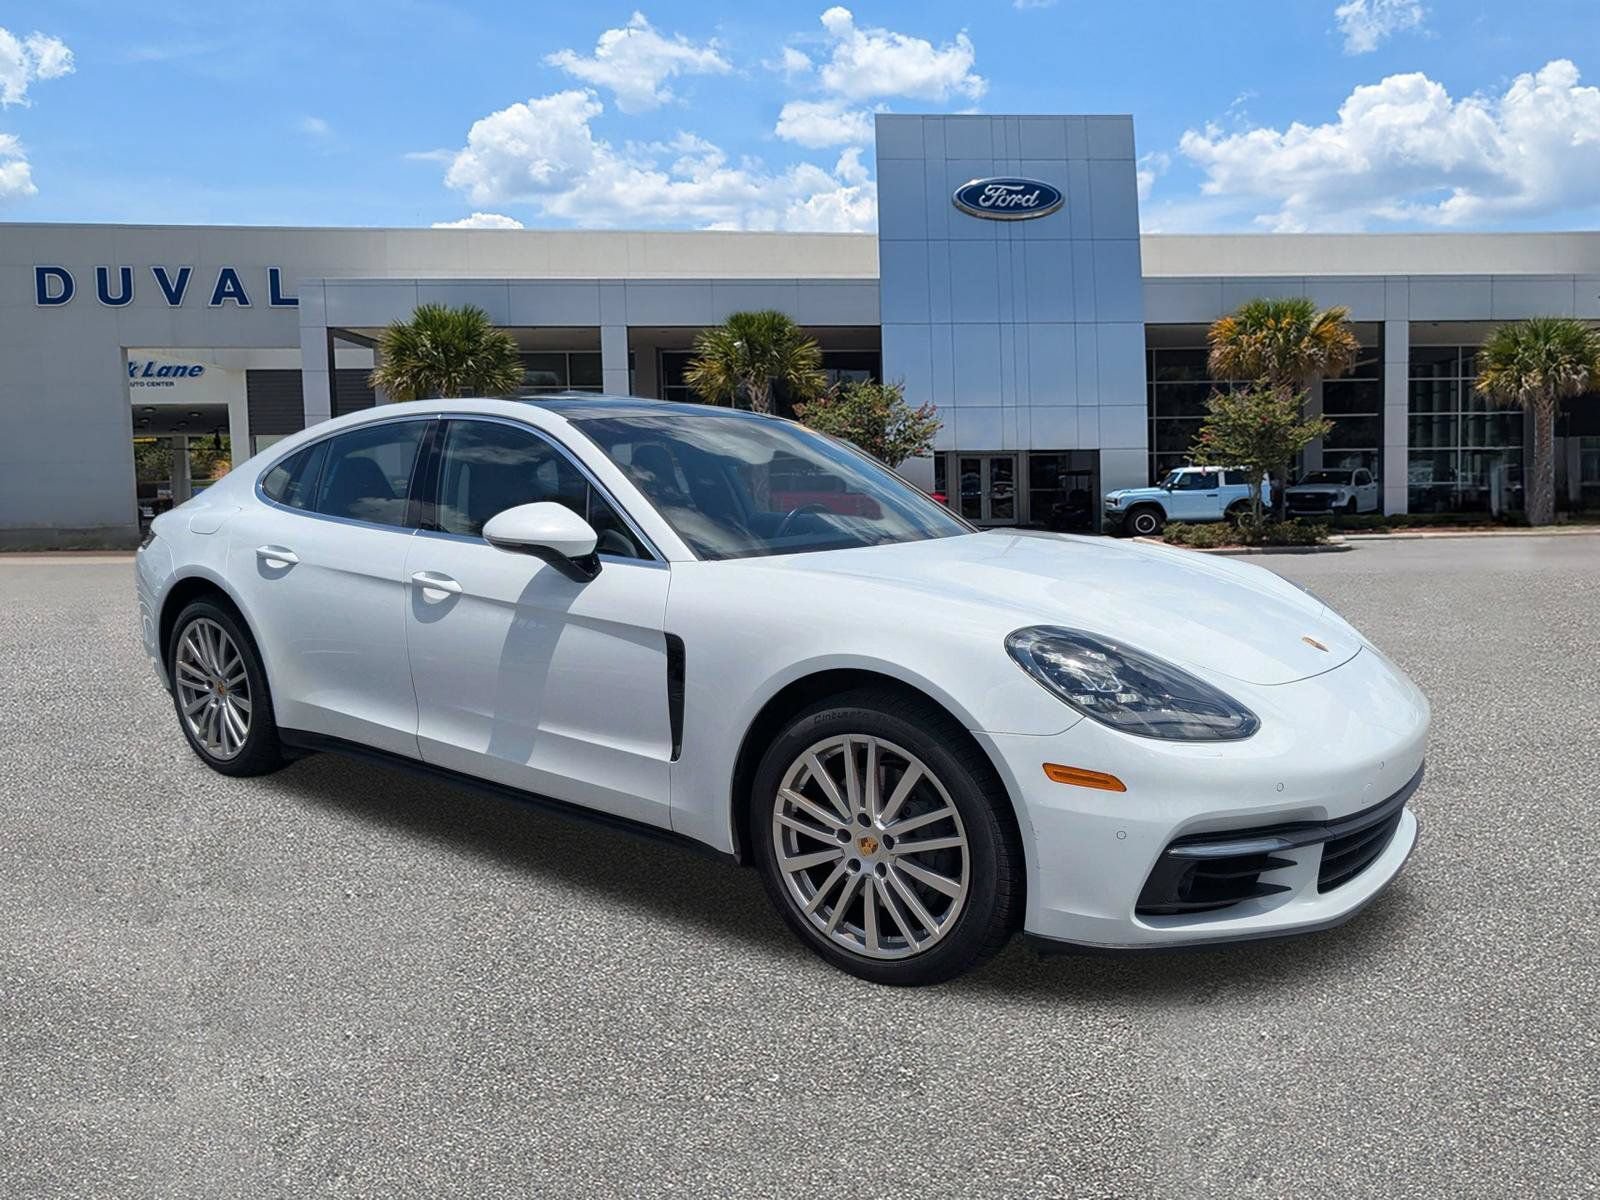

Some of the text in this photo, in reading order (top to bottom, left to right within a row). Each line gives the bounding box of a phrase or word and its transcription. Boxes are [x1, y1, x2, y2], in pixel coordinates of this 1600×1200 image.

[978, 184, 1040, 207] Ford
[33, 265, 300, 307] DUVAL
[141, 361, 204, 377] Lane
